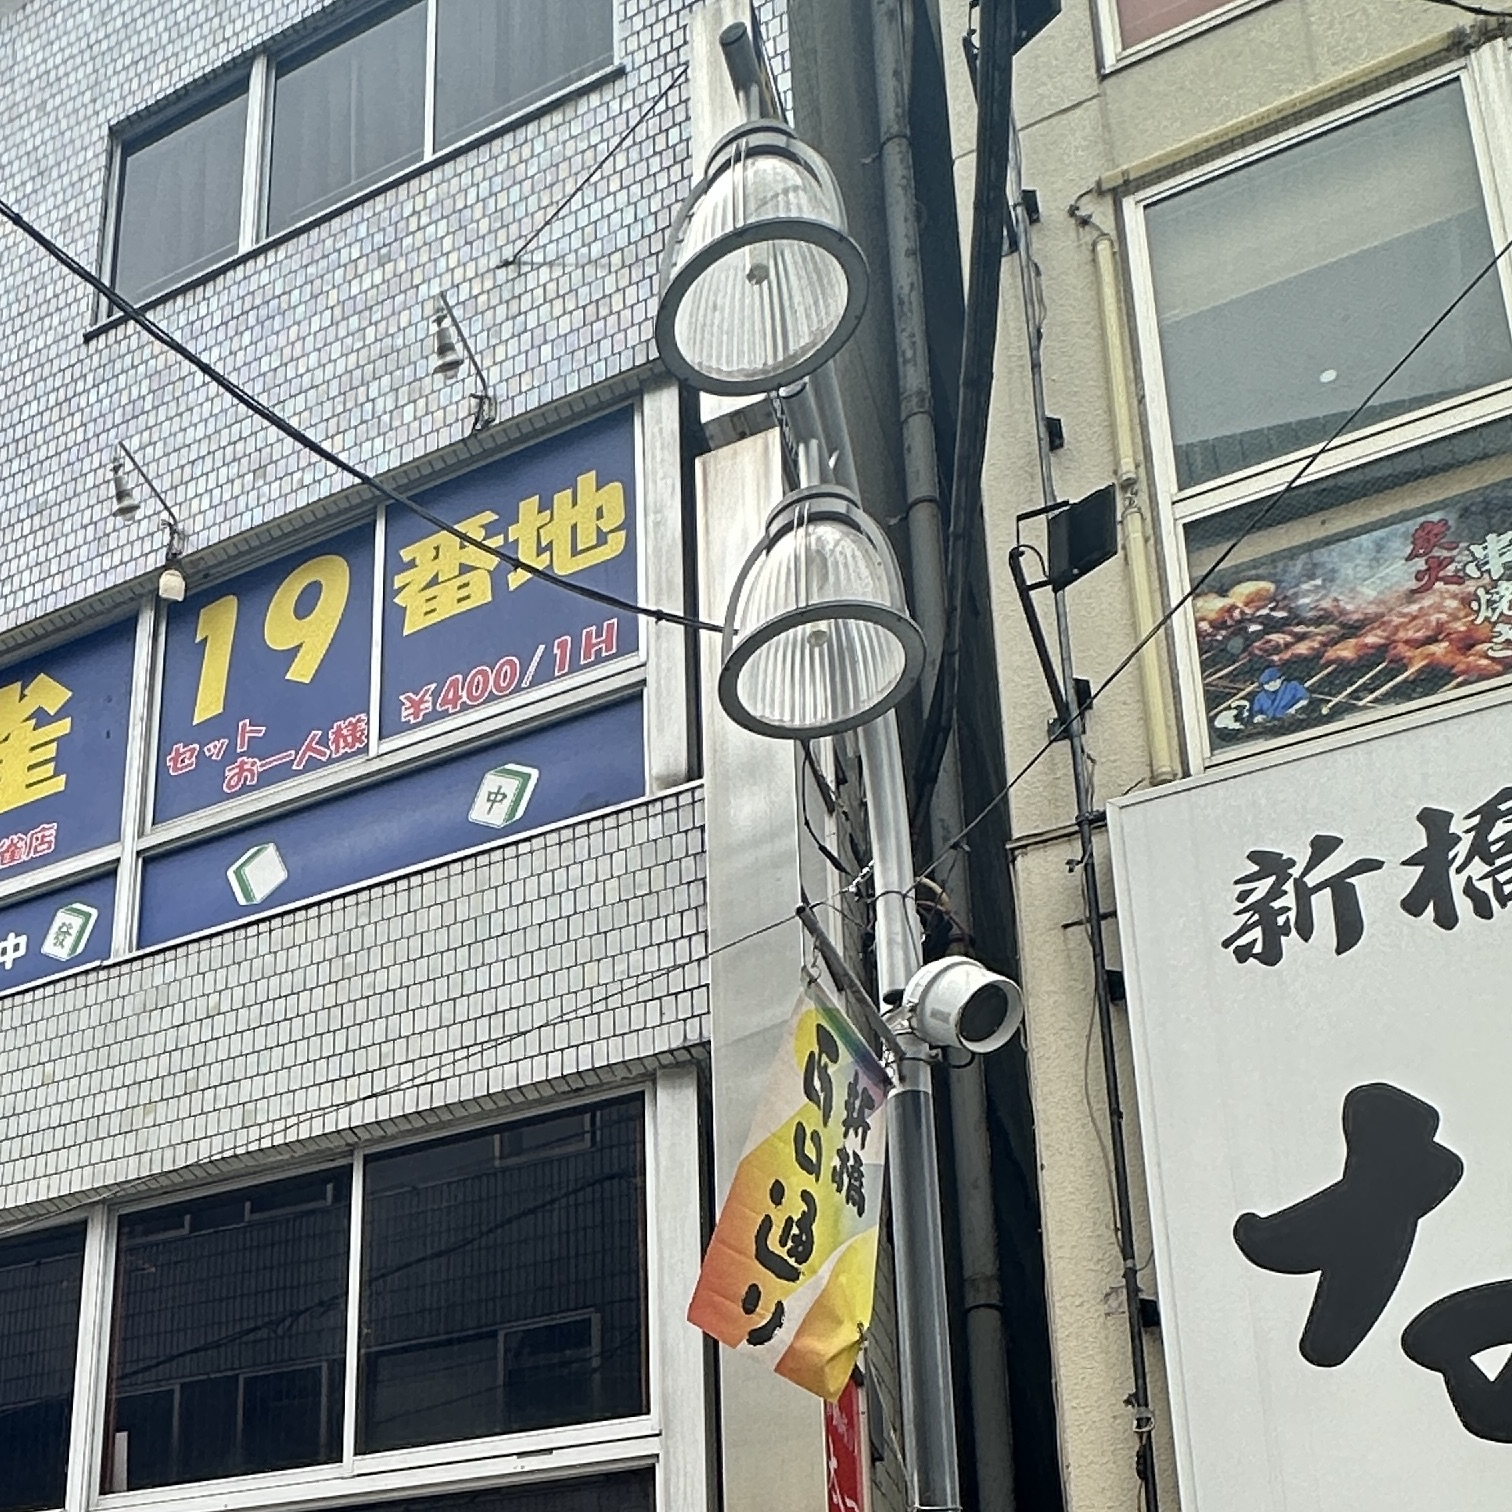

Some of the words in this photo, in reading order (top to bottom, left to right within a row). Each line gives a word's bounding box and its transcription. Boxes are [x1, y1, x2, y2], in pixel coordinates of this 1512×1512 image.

[166, 719, 265, 776] セット
[223, 714, 370, 793] お一人様
